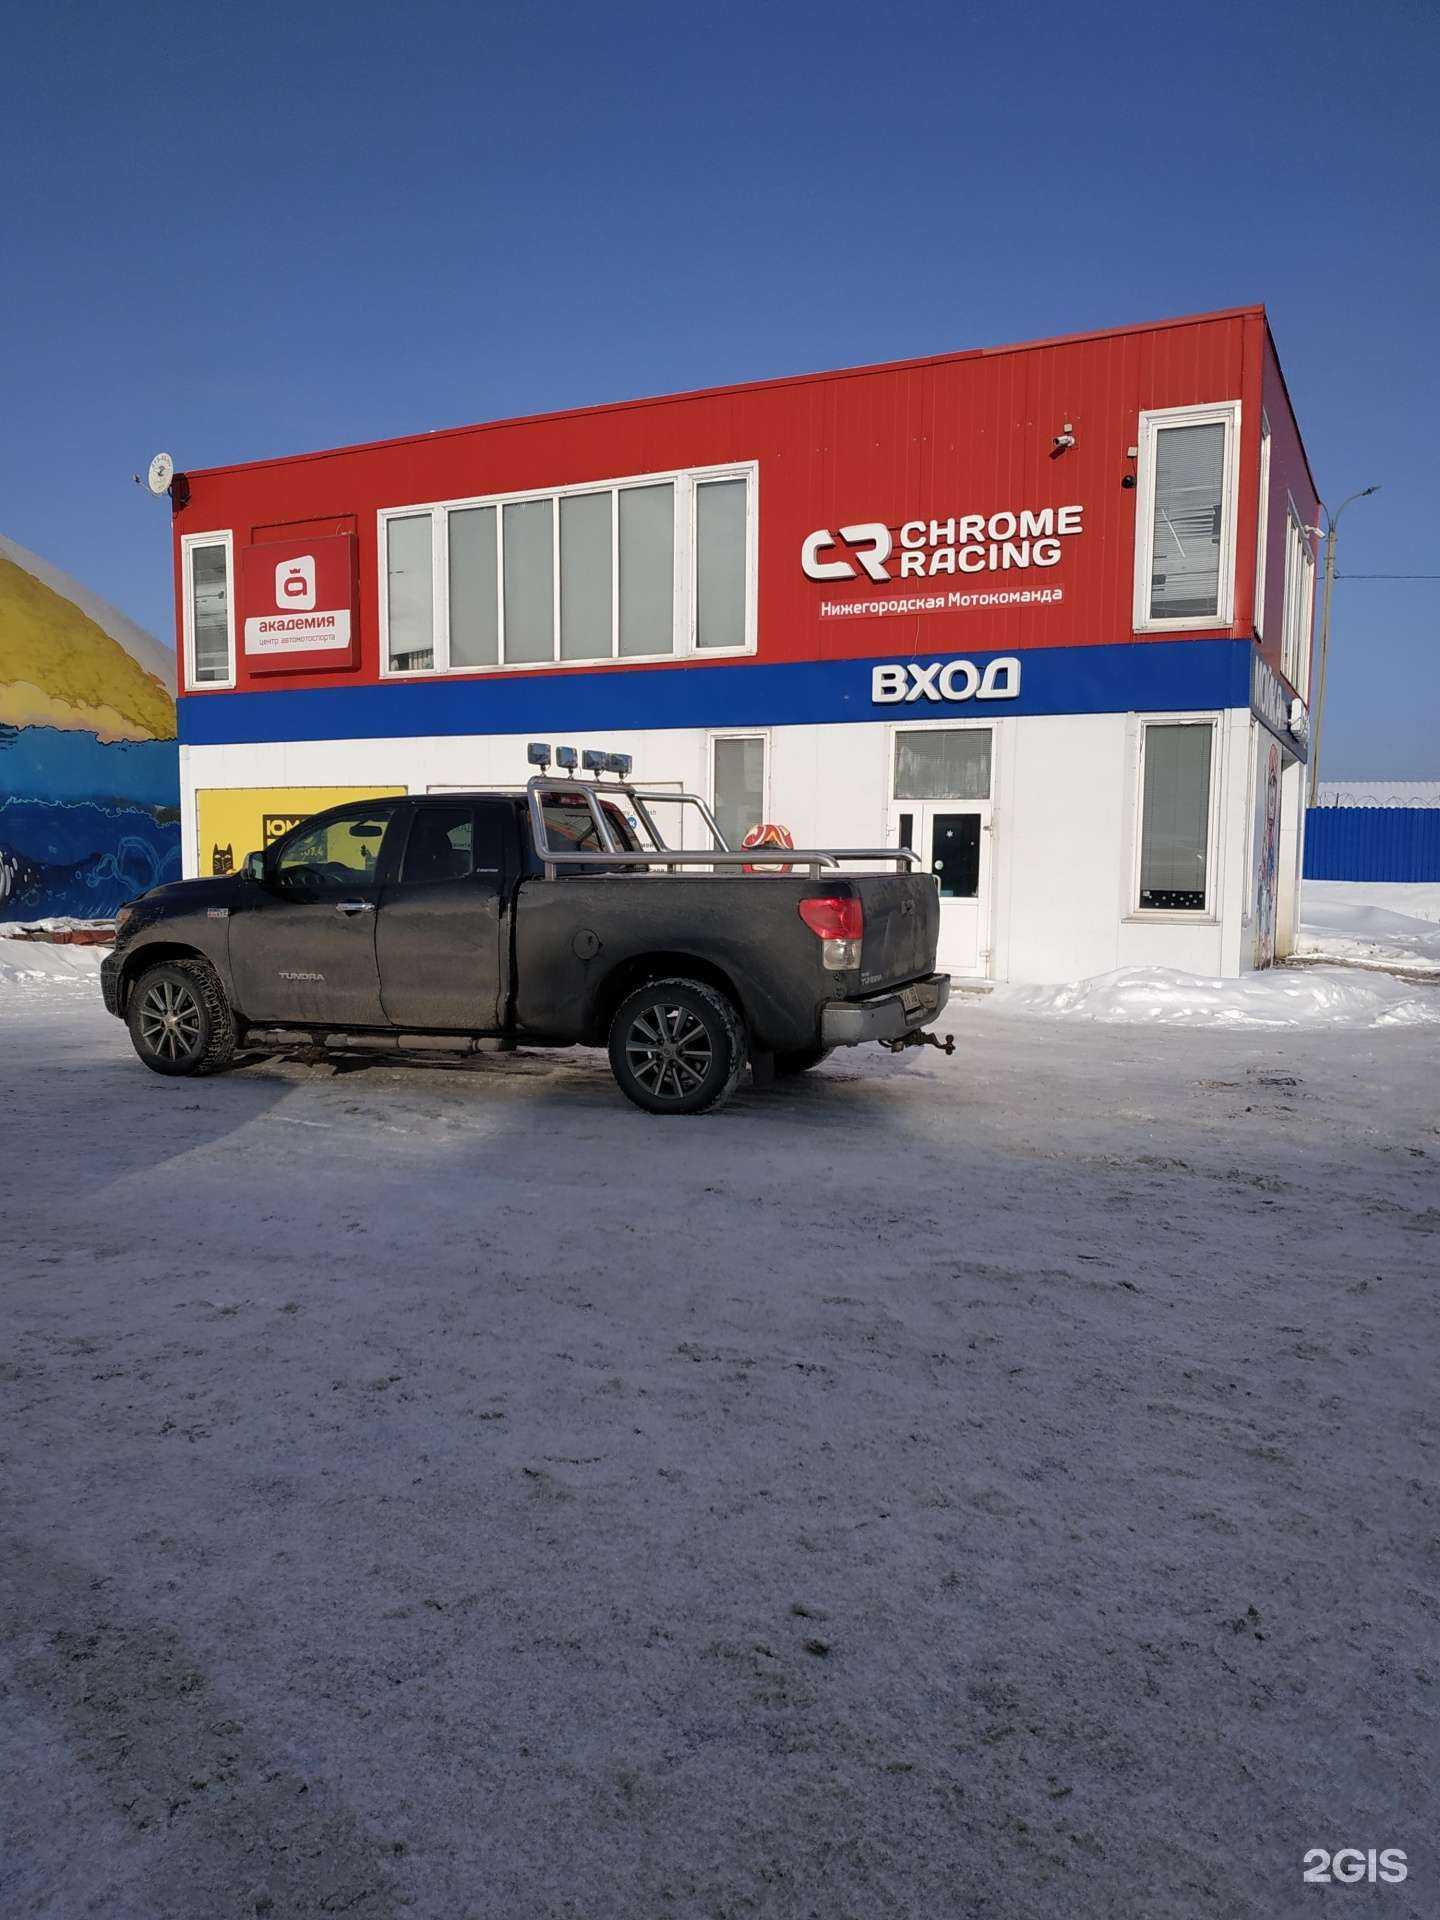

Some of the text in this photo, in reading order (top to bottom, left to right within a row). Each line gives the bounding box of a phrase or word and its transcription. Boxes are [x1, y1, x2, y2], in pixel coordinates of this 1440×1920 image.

[900, 505, 1084, 549] CHROME
[900, 538, 1062, 578] RACING
[821, 588, 1063, 617] Нижегородская Мотокоманда
[259, 616, 335, 633] академия
[259, 638, 279, 646] центр
[872, 657, 1022, 703] ВХОД
[278, 972, 325, 981] TUNDRA
